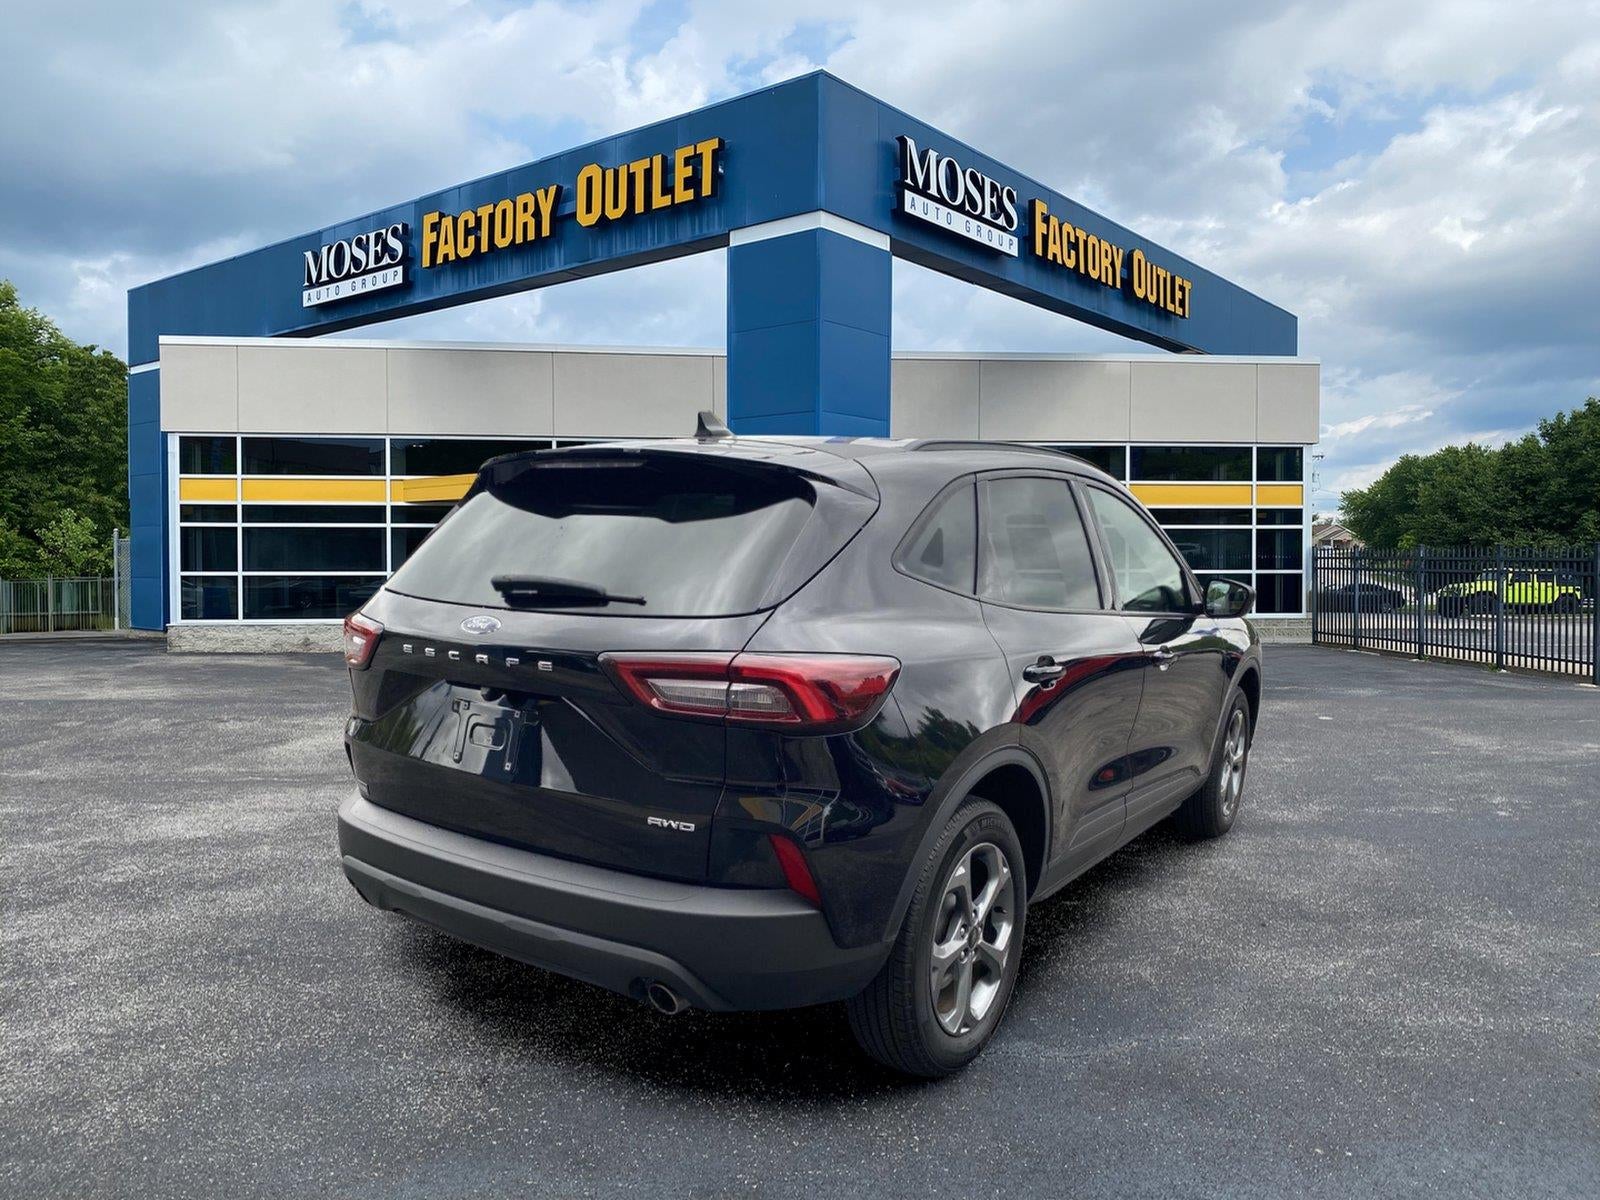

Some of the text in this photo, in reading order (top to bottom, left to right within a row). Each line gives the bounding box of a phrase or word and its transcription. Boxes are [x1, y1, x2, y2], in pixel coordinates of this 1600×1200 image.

[421, 137, 721, 269] FACTORY OUTLET
[902, 134, 1019, 231] MOSES
[909, 196, 1016, 251] AUTO GROUP
[303, 223, 404, 287] MOSES
[1034, 197, 1192, 318] FACTORY OUTLET
[306, 269, 400, 304] AUTO GROUP
[402, 643, 553, 672] ESCAPE
[647, 816, 695, 832] AWD
